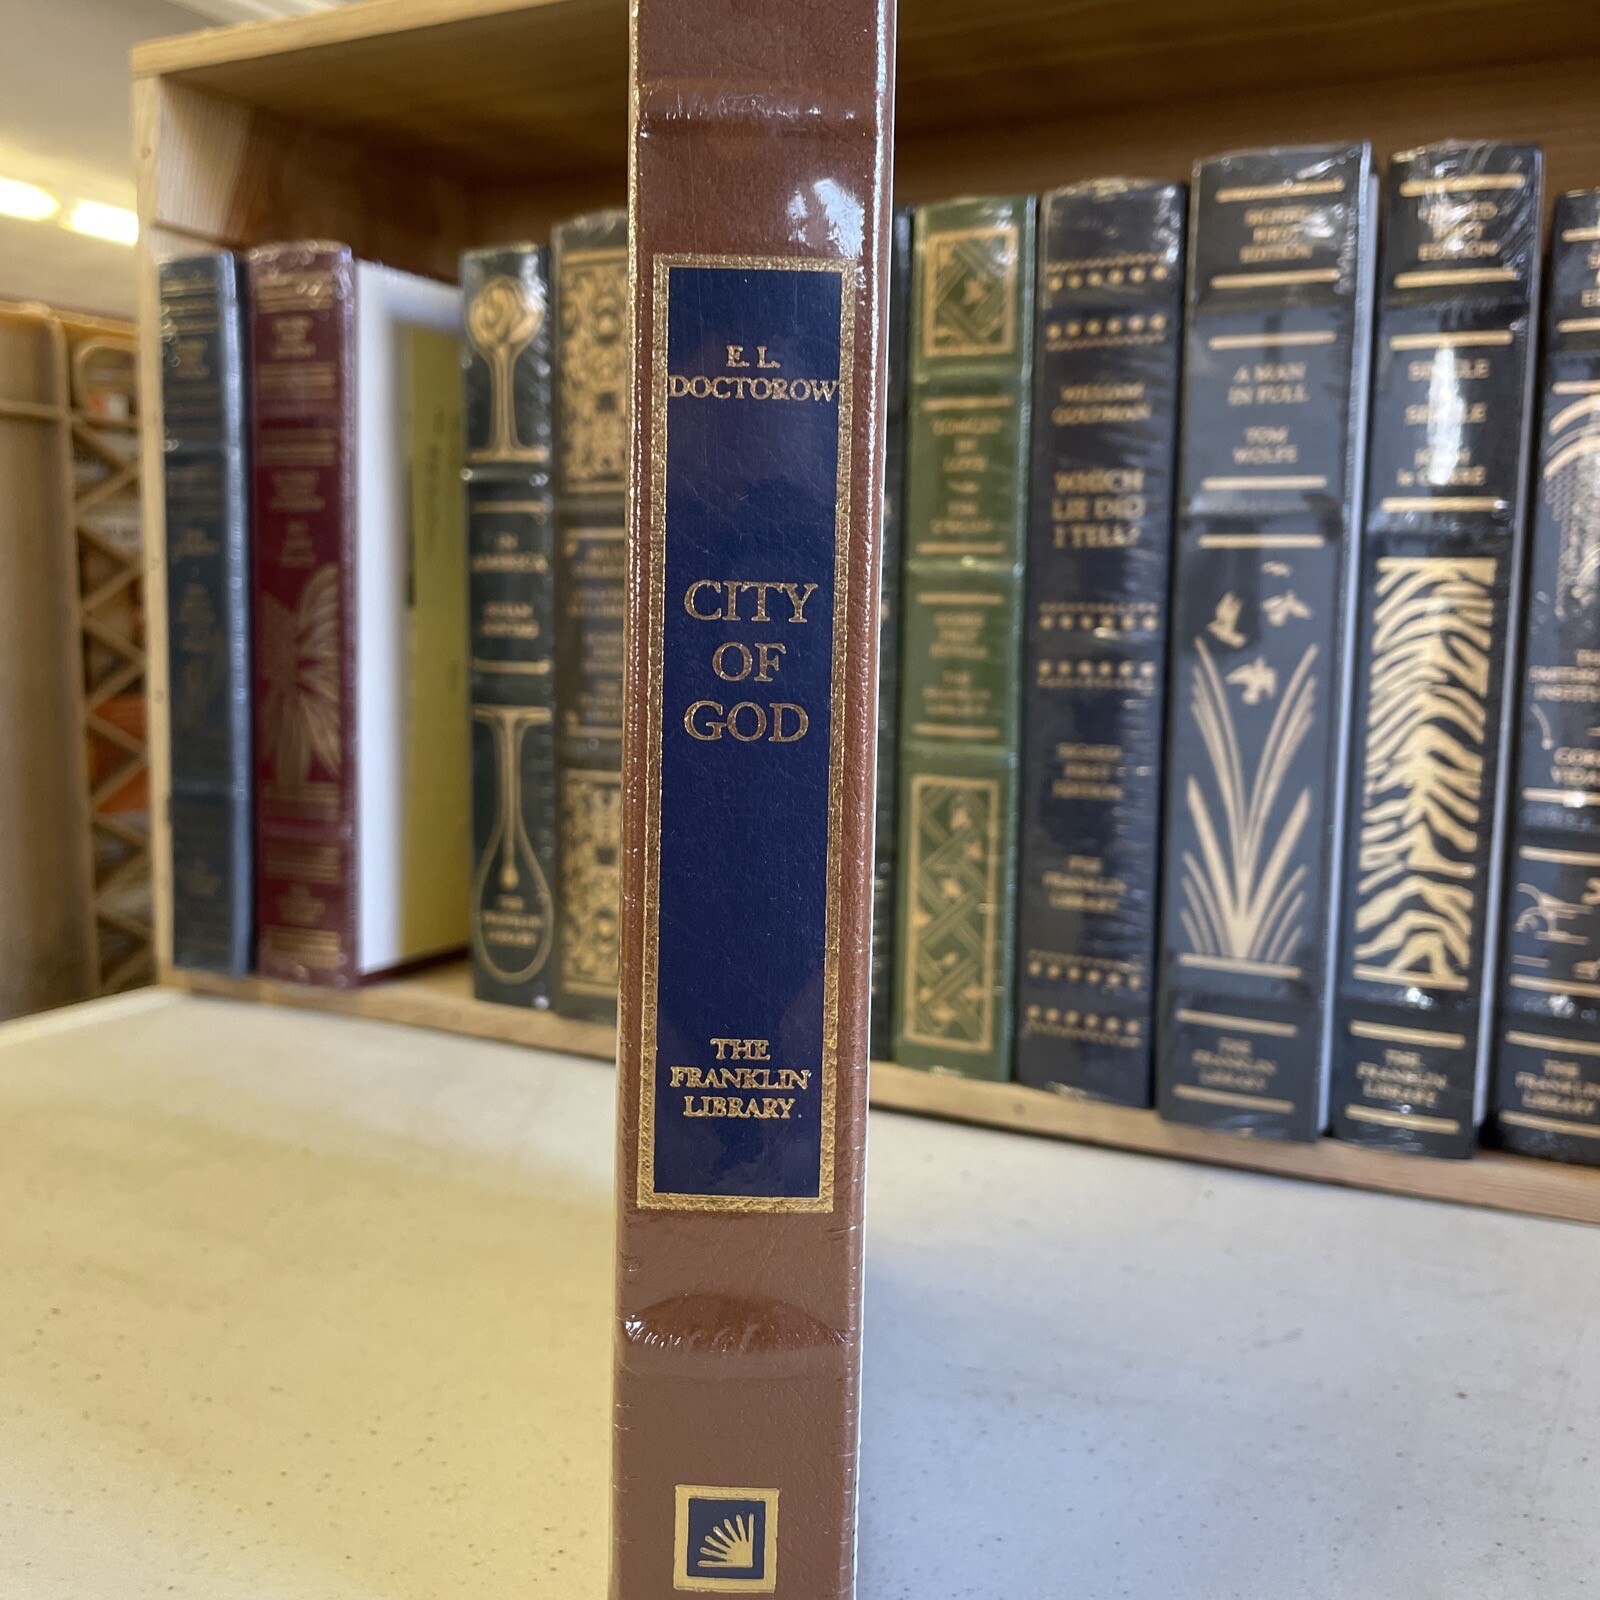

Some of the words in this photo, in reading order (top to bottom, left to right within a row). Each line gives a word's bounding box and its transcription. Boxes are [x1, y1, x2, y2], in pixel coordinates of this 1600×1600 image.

[726, 344, 750, 368] E.
[757, 345, 781, 368] L.
[669, 374, 841, 402] DOCTOROW
[683, 580, 819, 624] CITY
[712, 641, 787, 683] OF
[683, 700, 810, 743] GOD
[710, 1037, 771, 1061] THE
[669, 1066, 812, 1090] FRANKLIN
[683, 1095, 796, 1119] LIBRARY
